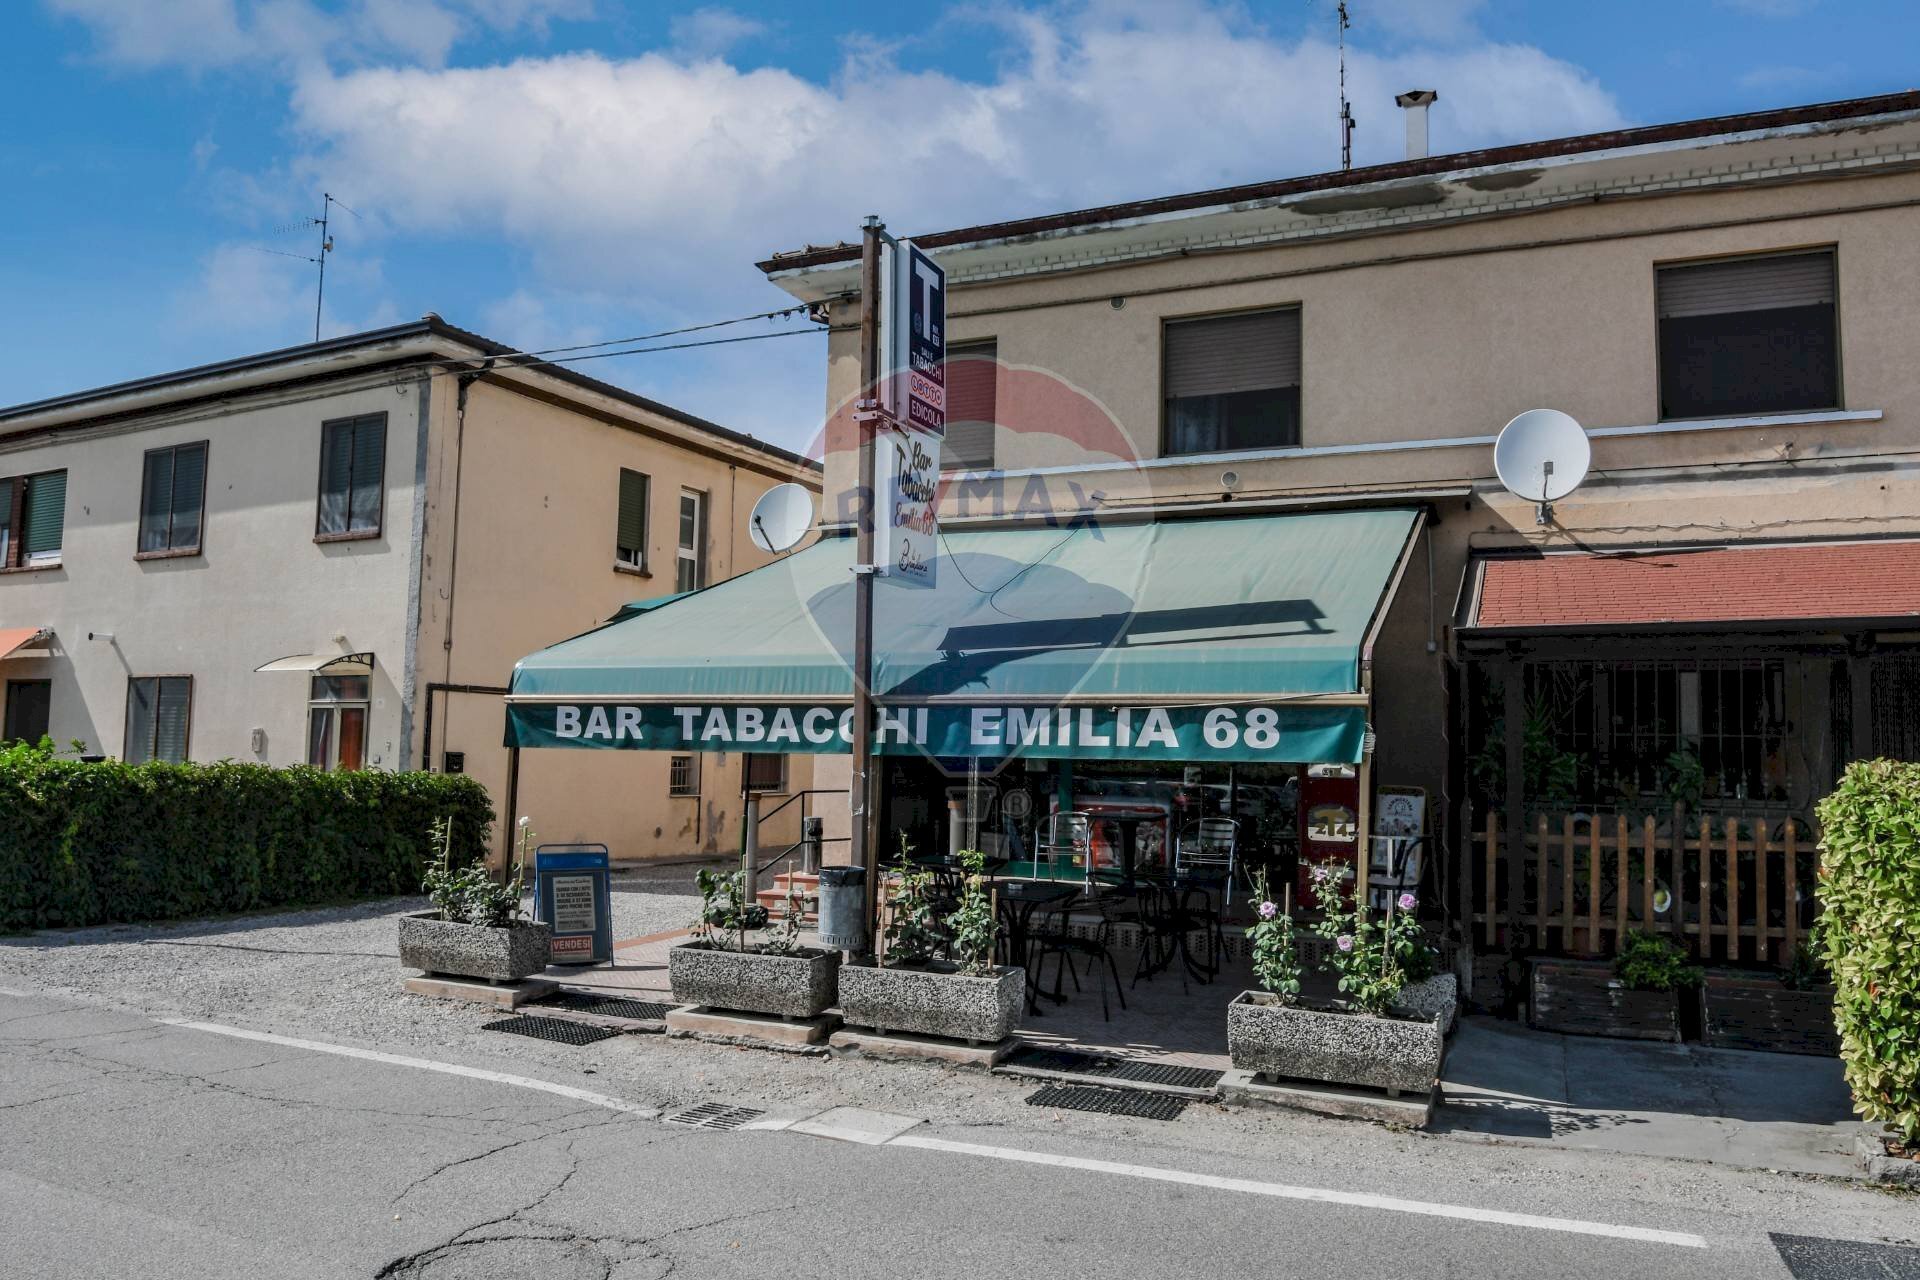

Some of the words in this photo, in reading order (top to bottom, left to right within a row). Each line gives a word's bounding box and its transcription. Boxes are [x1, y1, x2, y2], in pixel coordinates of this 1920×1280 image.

[915, 258, 939, 342] T
[912, 351, 943, 381] TABACCHI
[911, 375, 942, 406] LOTTO
[911, 399, 941, 429] EDICOLA
[912, 441, 932, 472] Bar
[896, 443, 935, 503] Tabacchi
[895, 502, 922, 532] Emilia
[922, 511, 935, 537] 68
[555, 706, 643, 740] BAR
[970, 707, 1179, 748] EMILIA
[1203, 707, 1280, 749] 68
[553, 939, 590, 950] VENDESI
